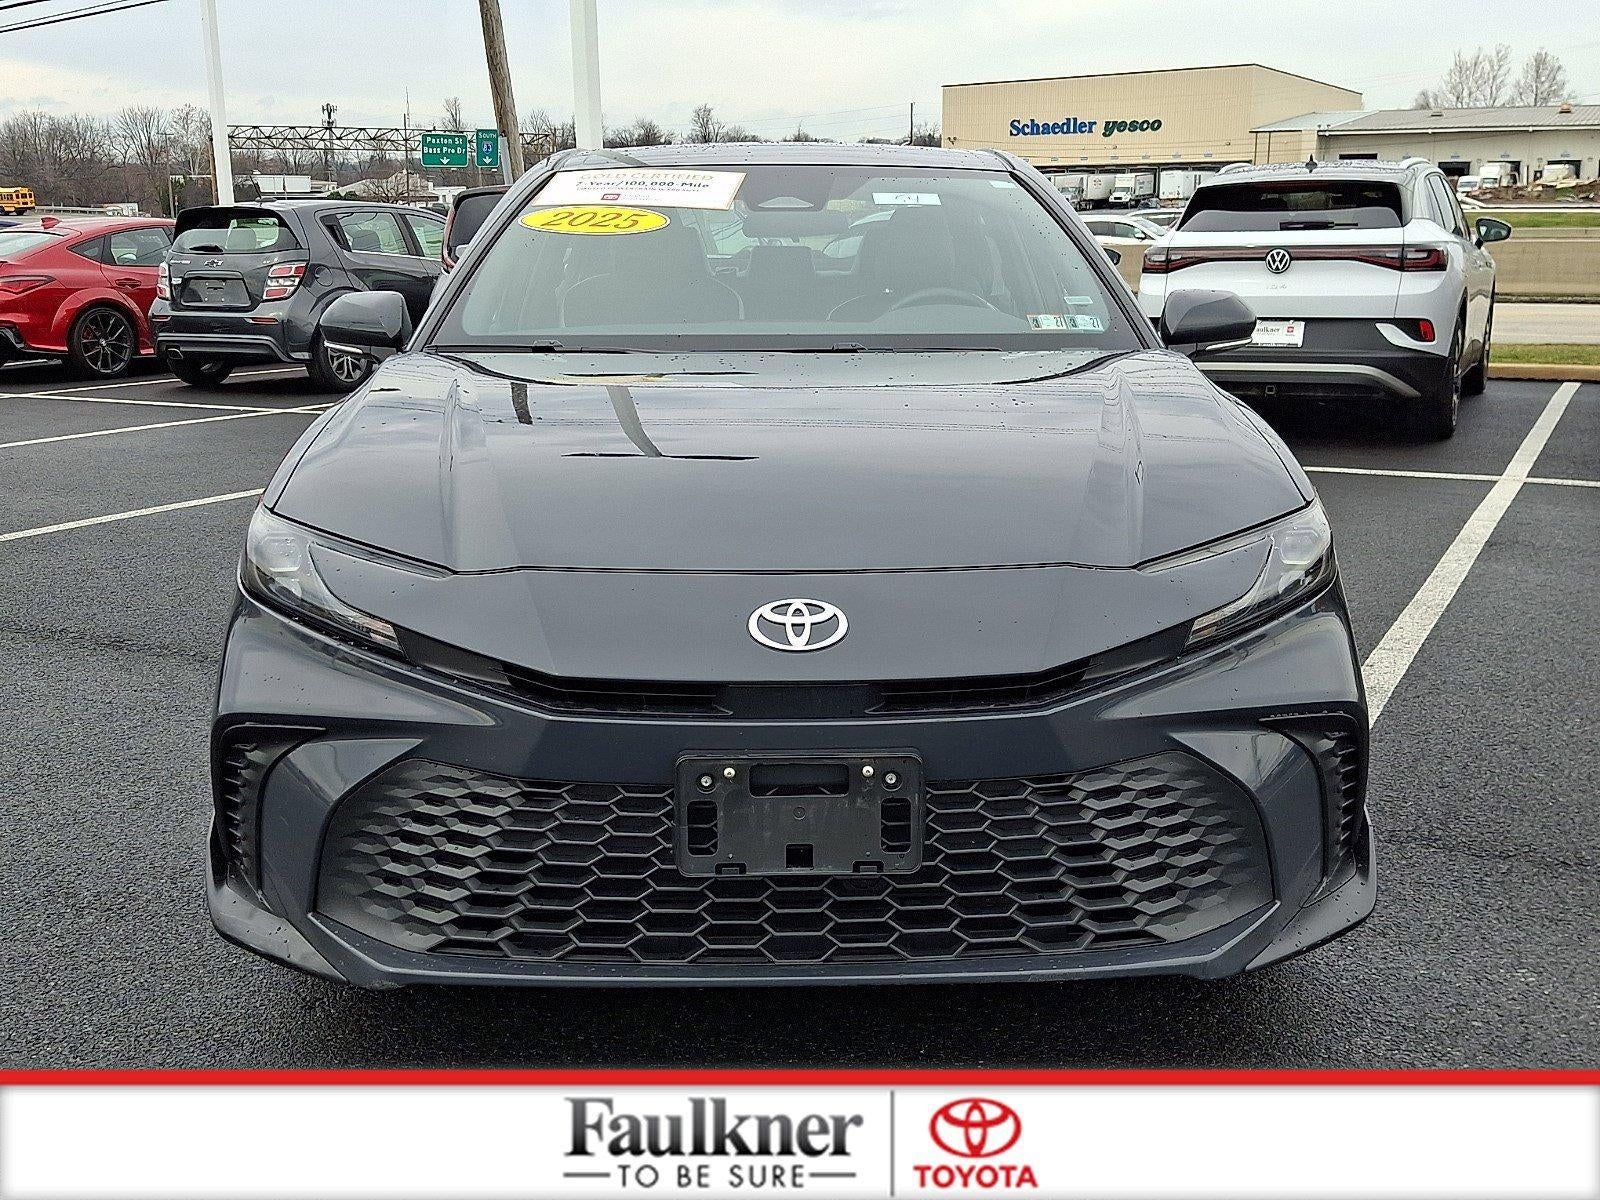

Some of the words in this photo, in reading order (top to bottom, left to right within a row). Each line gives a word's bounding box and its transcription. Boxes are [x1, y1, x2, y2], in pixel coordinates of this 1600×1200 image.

[1009, 117, 1097, 137] Schaedler
[426, 136, 453, 145] Paxton
[454, 137, 463, 145] St
[423, 146, 441, 154] Bass
[442, 146, 456, 154] Pro
[456, 146, 466, 154] Dr
[630, 172, 714, 181] CERTIFIED
[540, 211, 648, 229] 2025
